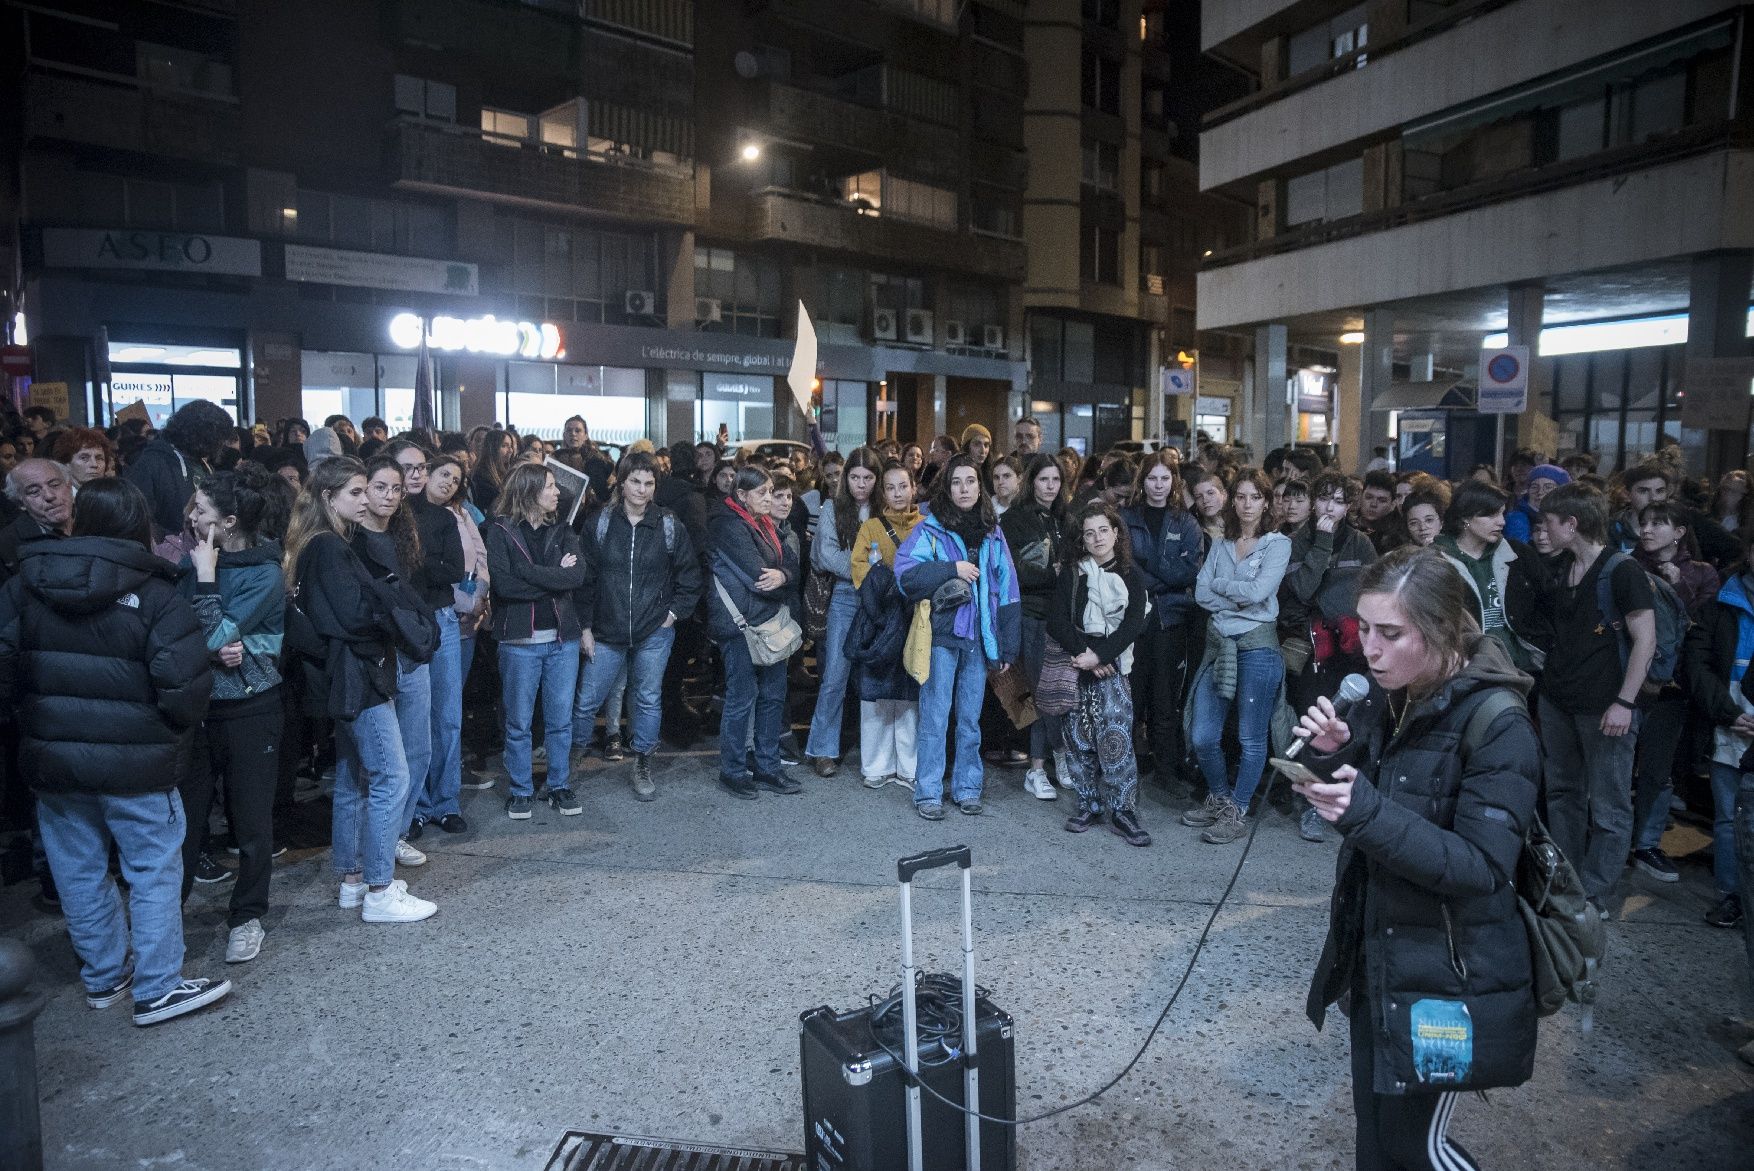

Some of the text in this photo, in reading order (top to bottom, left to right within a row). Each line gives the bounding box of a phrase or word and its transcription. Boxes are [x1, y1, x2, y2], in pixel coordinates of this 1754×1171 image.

[692, 349, 705, 362] de
[706, 352, 742, 365] sempre,
[743, 353, 770, 367] global
